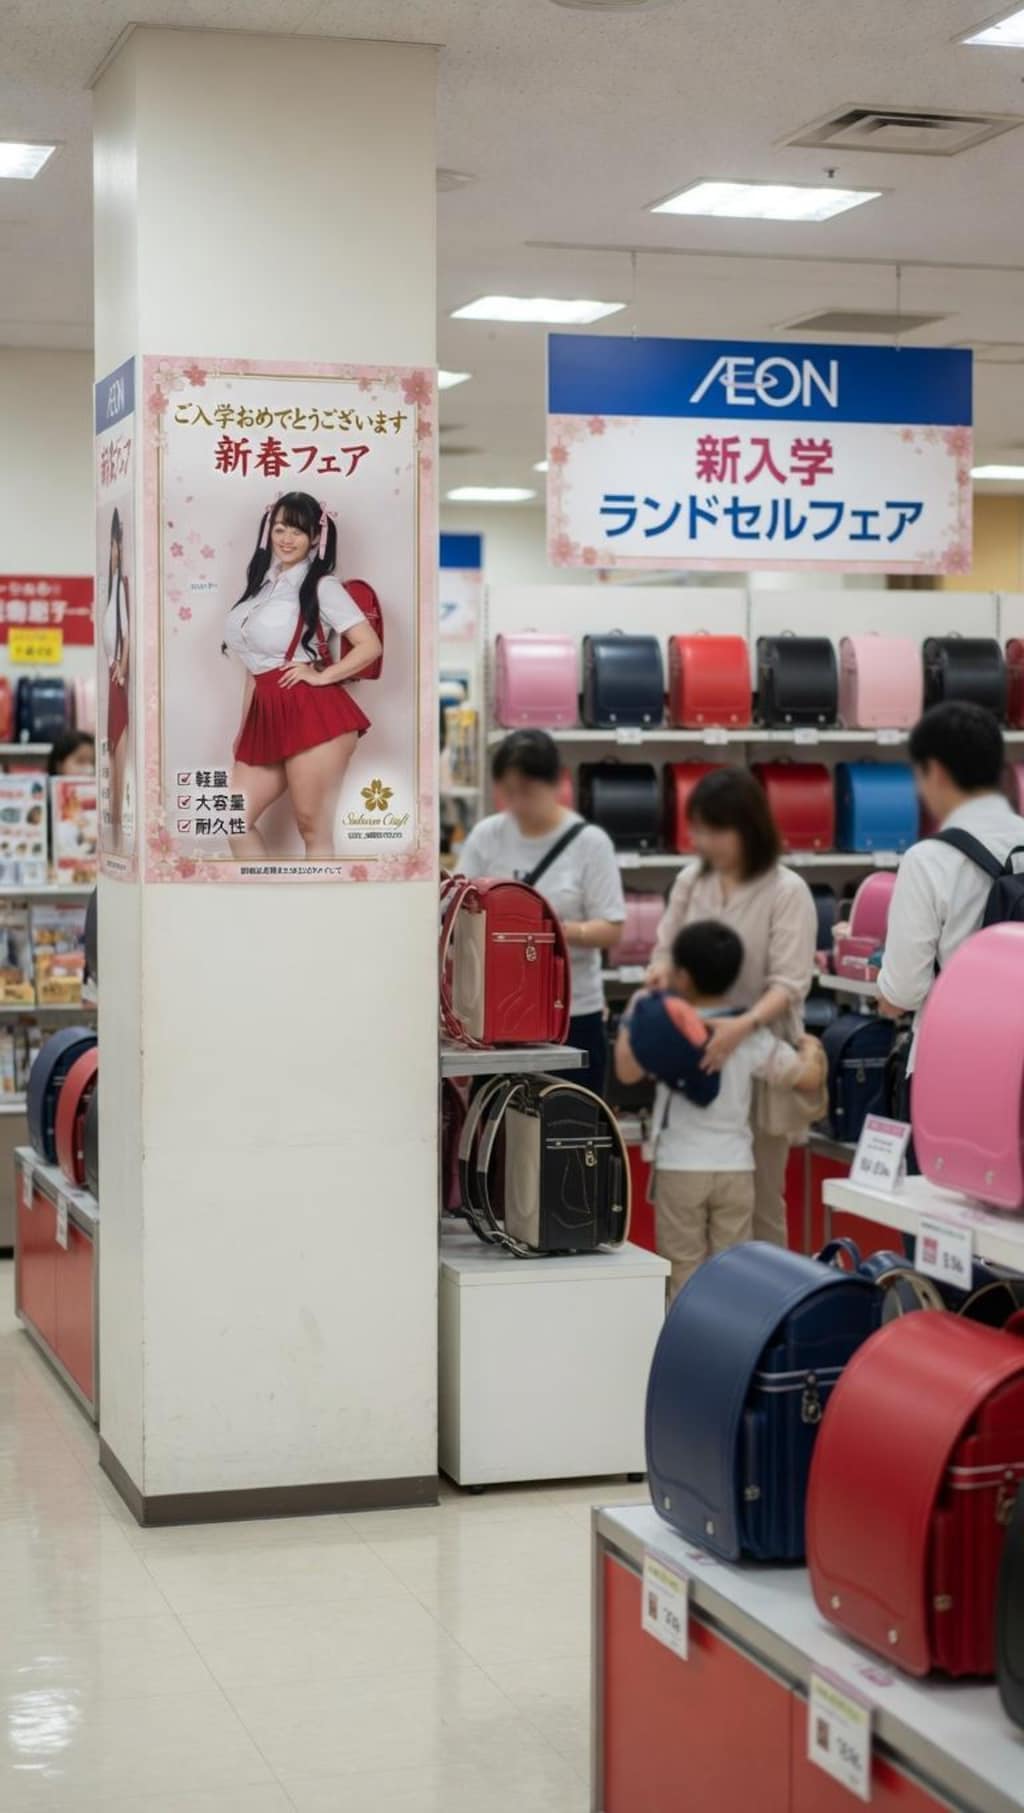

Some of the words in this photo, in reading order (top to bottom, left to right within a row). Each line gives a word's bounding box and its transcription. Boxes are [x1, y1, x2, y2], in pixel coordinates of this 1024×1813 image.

[174, 403, 409, 434] ご入学おめでとうございます
[214, 435, 371, 477] 新春フェア
[696, 435, 834, 486] 新入学
[599, 493, 925, 543] ランドセルフェア
[195, 817, 246, 835] 耐久性
